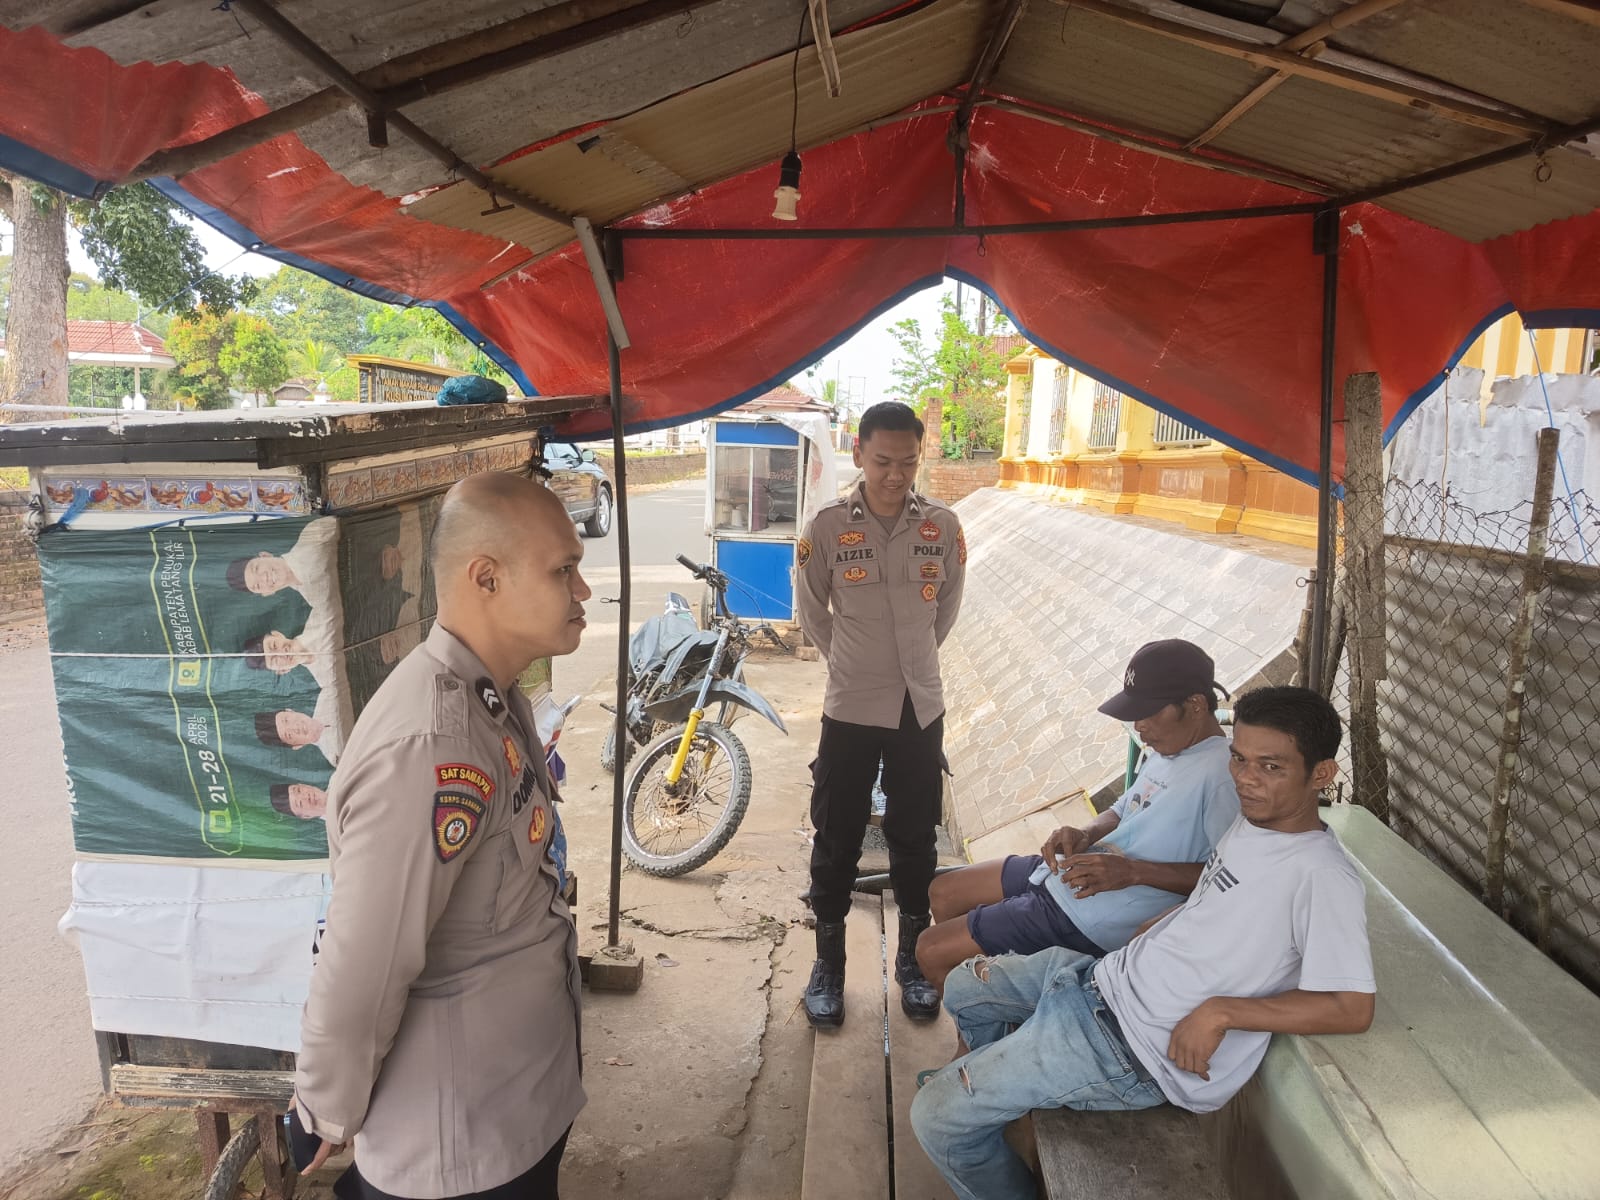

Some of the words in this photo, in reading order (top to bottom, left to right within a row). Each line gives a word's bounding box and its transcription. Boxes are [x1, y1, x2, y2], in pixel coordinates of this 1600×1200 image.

[161, 540, 176, 588] PENUKAL
[173, 542, 185, 560] ILIR
[835, 548, 873, 563] AIZIE
[913, 545, 944, 557] POLRI
[171, 563, 190, 624] LEMATANG
[165, 591, 188, 655] KABUPATEN
[182, 625, 198, 656] ABAB
[188, 714, 198, 745] APRIL
[197, 716, 208, 745] 2025
[198, 750, 228, 804] 21-28
[440, 767, 459, 780] SAT
[460, 768, 491, 795] SAMAPTA
